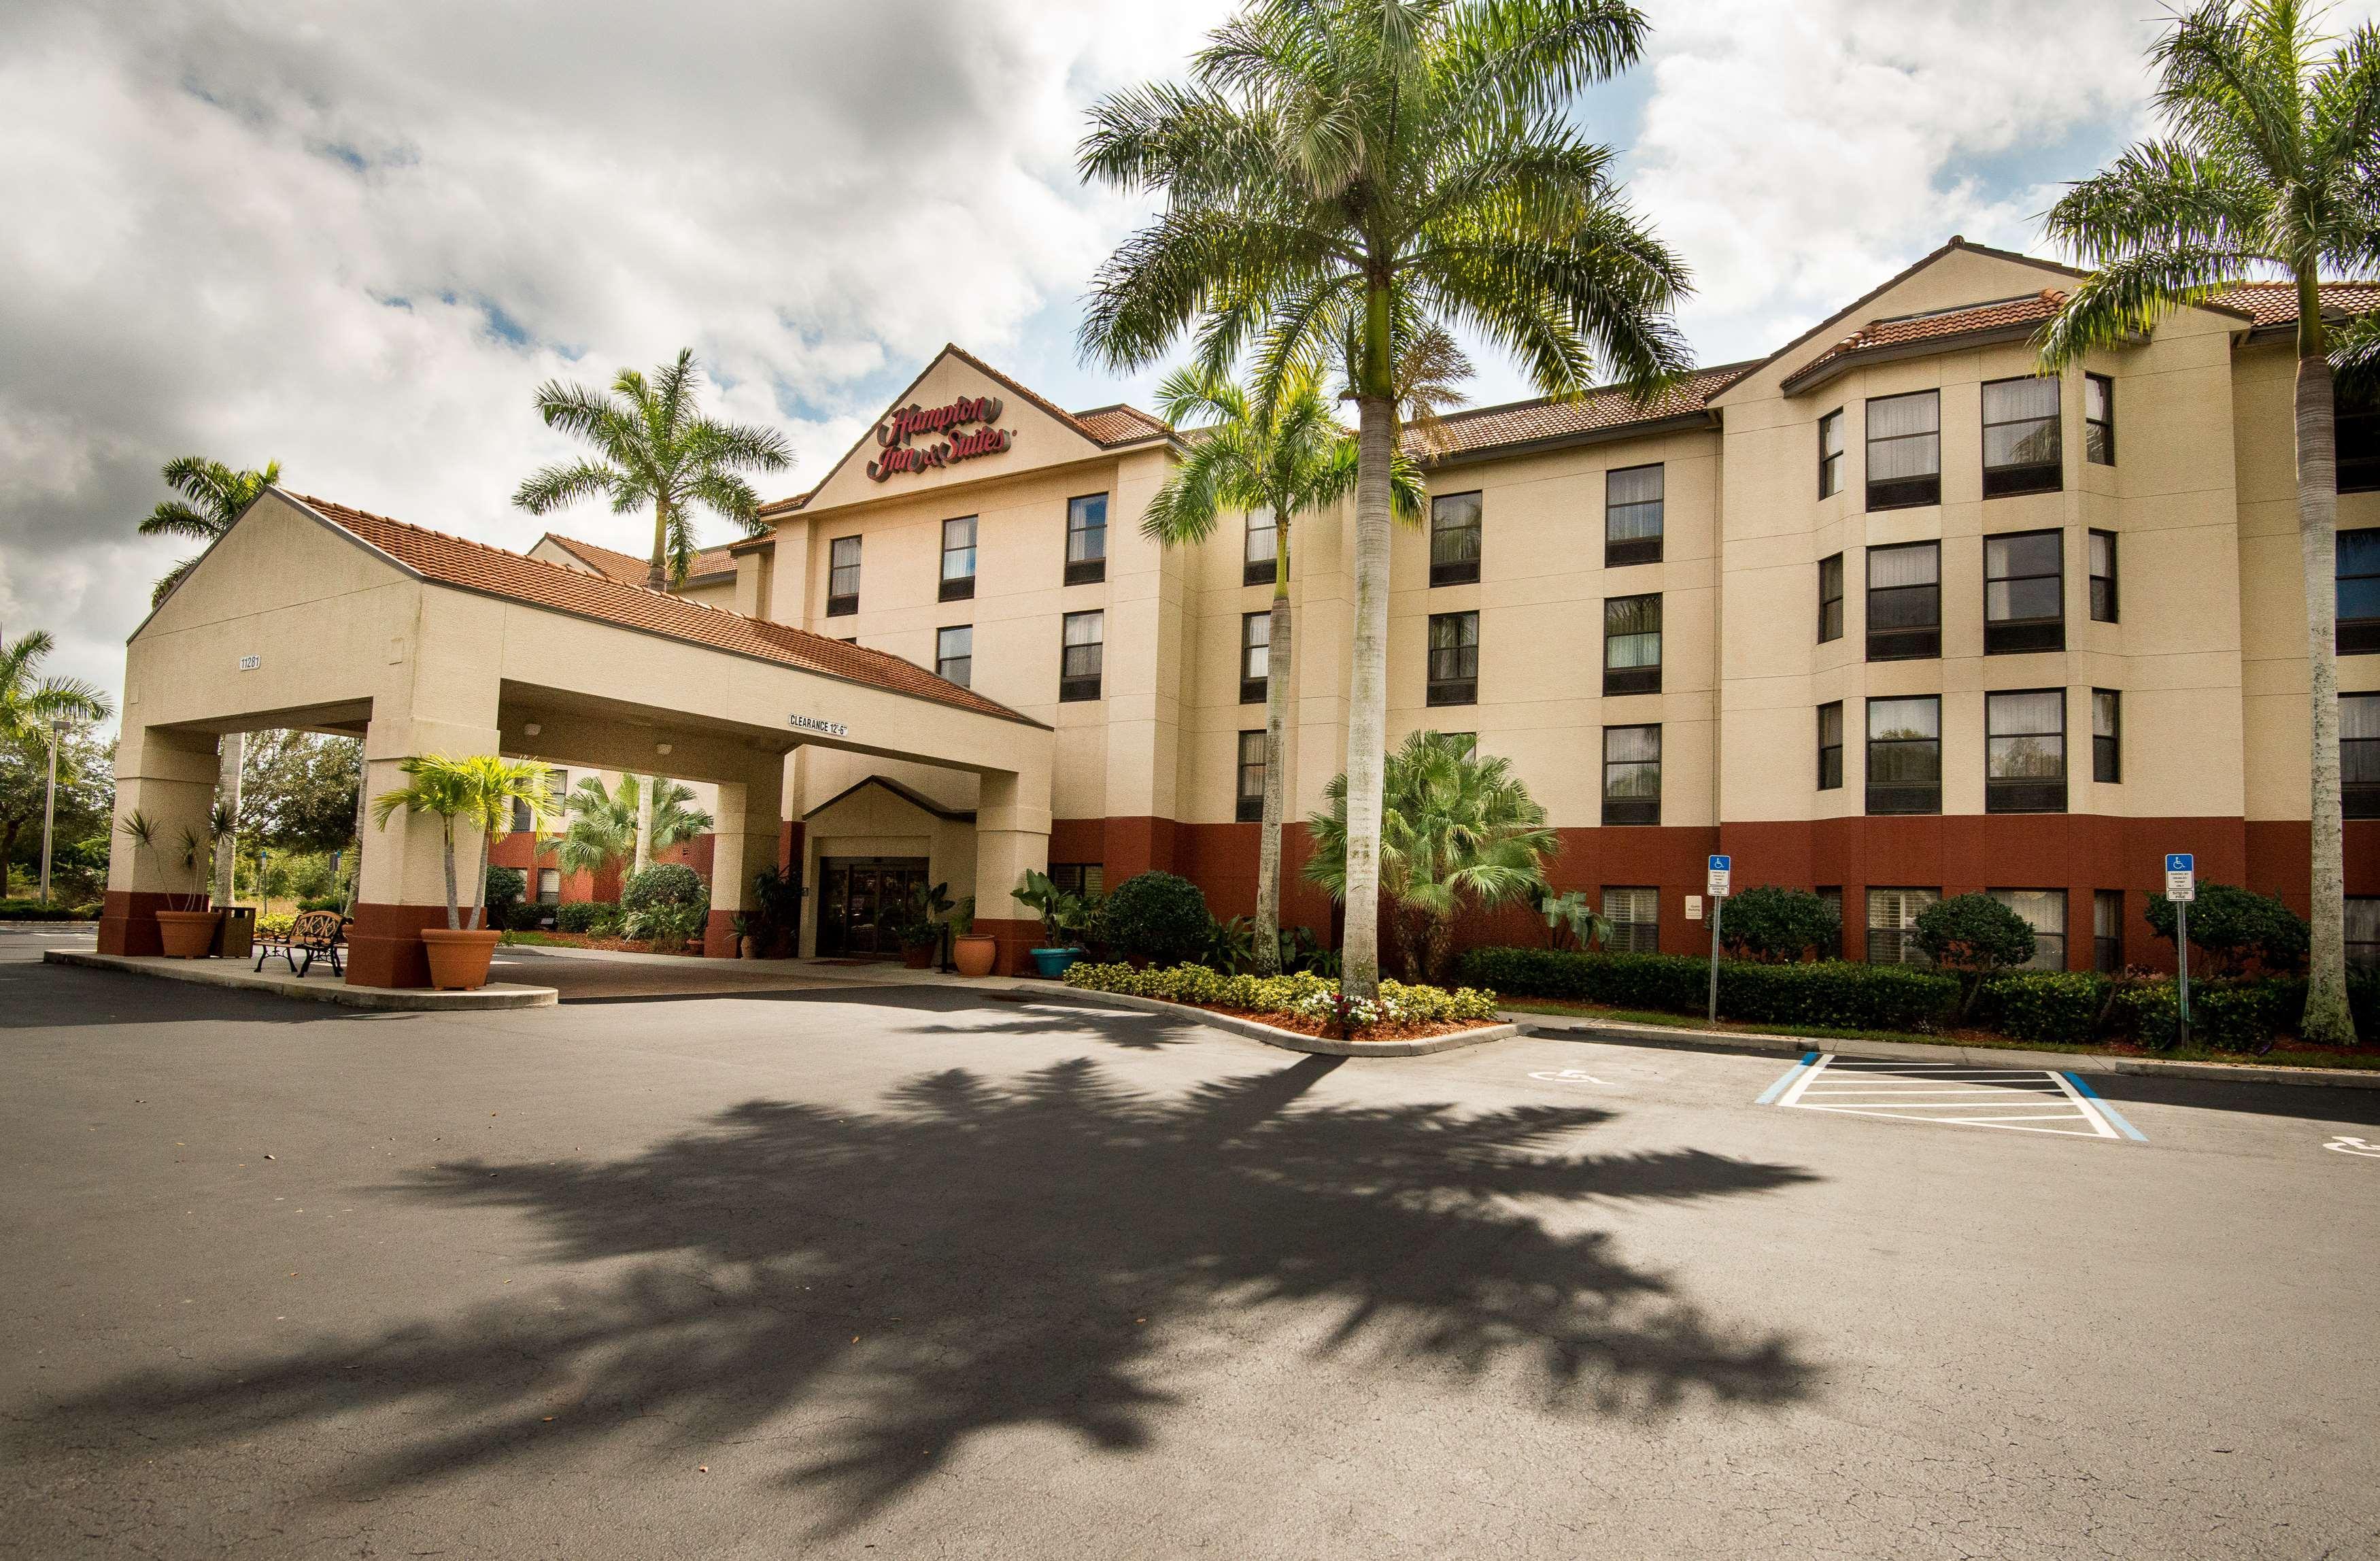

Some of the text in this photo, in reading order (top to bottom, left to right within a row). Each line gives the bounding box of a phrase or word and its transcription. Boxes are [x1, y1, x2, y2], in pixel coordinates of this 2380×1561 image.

[877, 396, 1003, 448] Hampton
[866, 446, 928, 482] Inn
[938, 426, 1011, 464] Suites
[241, 656, 259, 668] 11281
[790, 715, 828, 732] CLEARANCE
